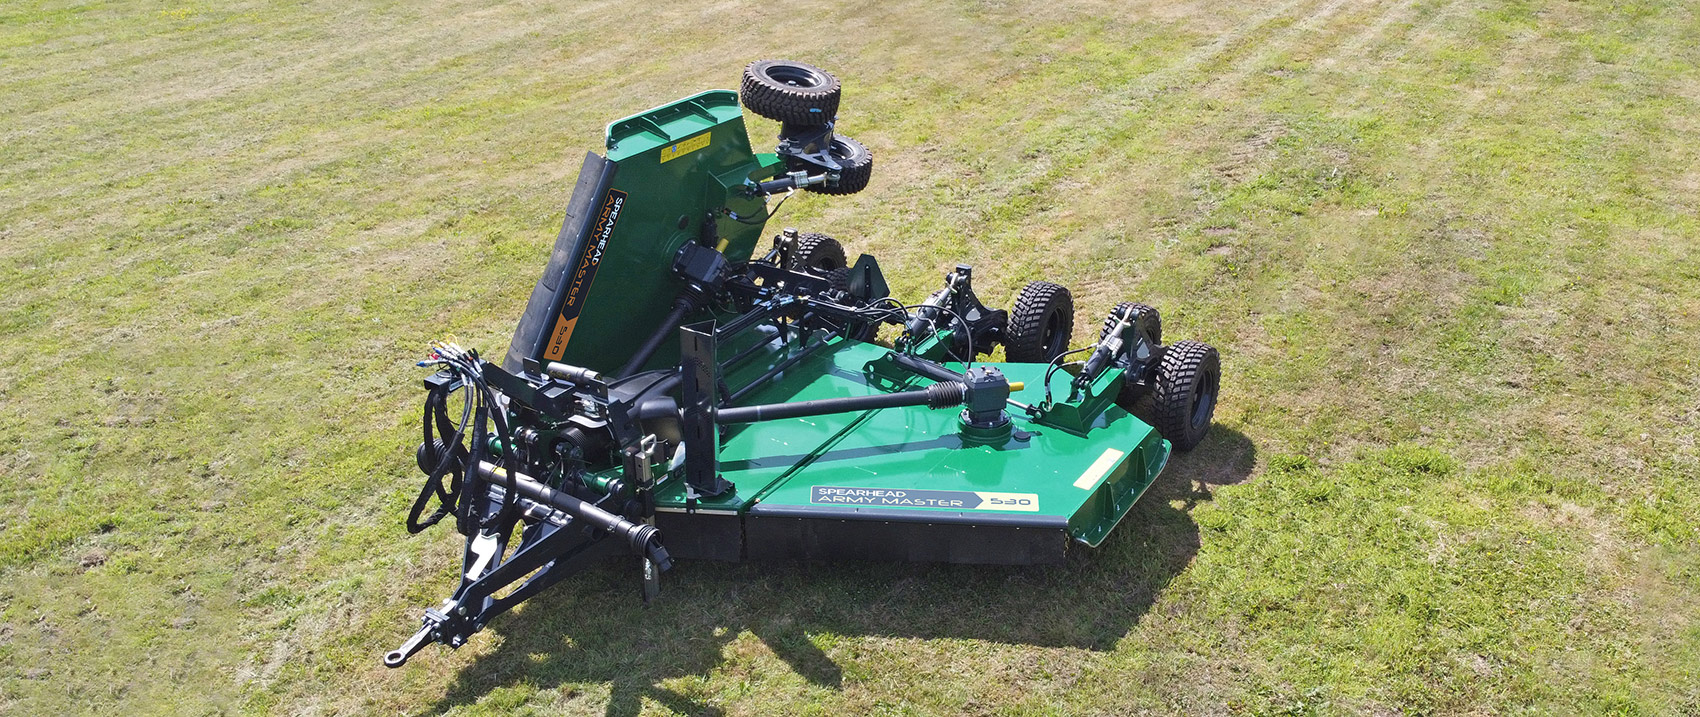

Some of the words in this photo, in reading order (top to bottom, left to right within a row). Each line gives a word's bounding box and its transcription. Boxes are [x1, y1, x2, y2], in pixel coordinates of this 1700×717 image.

[591, 197, 623, 266] SPEARHEAD
[593, 194, 614, 242] ARMY
[567, 244, 596, 307] MASTER
[551, 326, 568, 355] 530
[818, 488, 907, 498] SPEARHEAD
[818, 495, 876, 504] ARMY
[882, 497, 963, 507] MASTER
[990, 497, 1031, 506] 530
